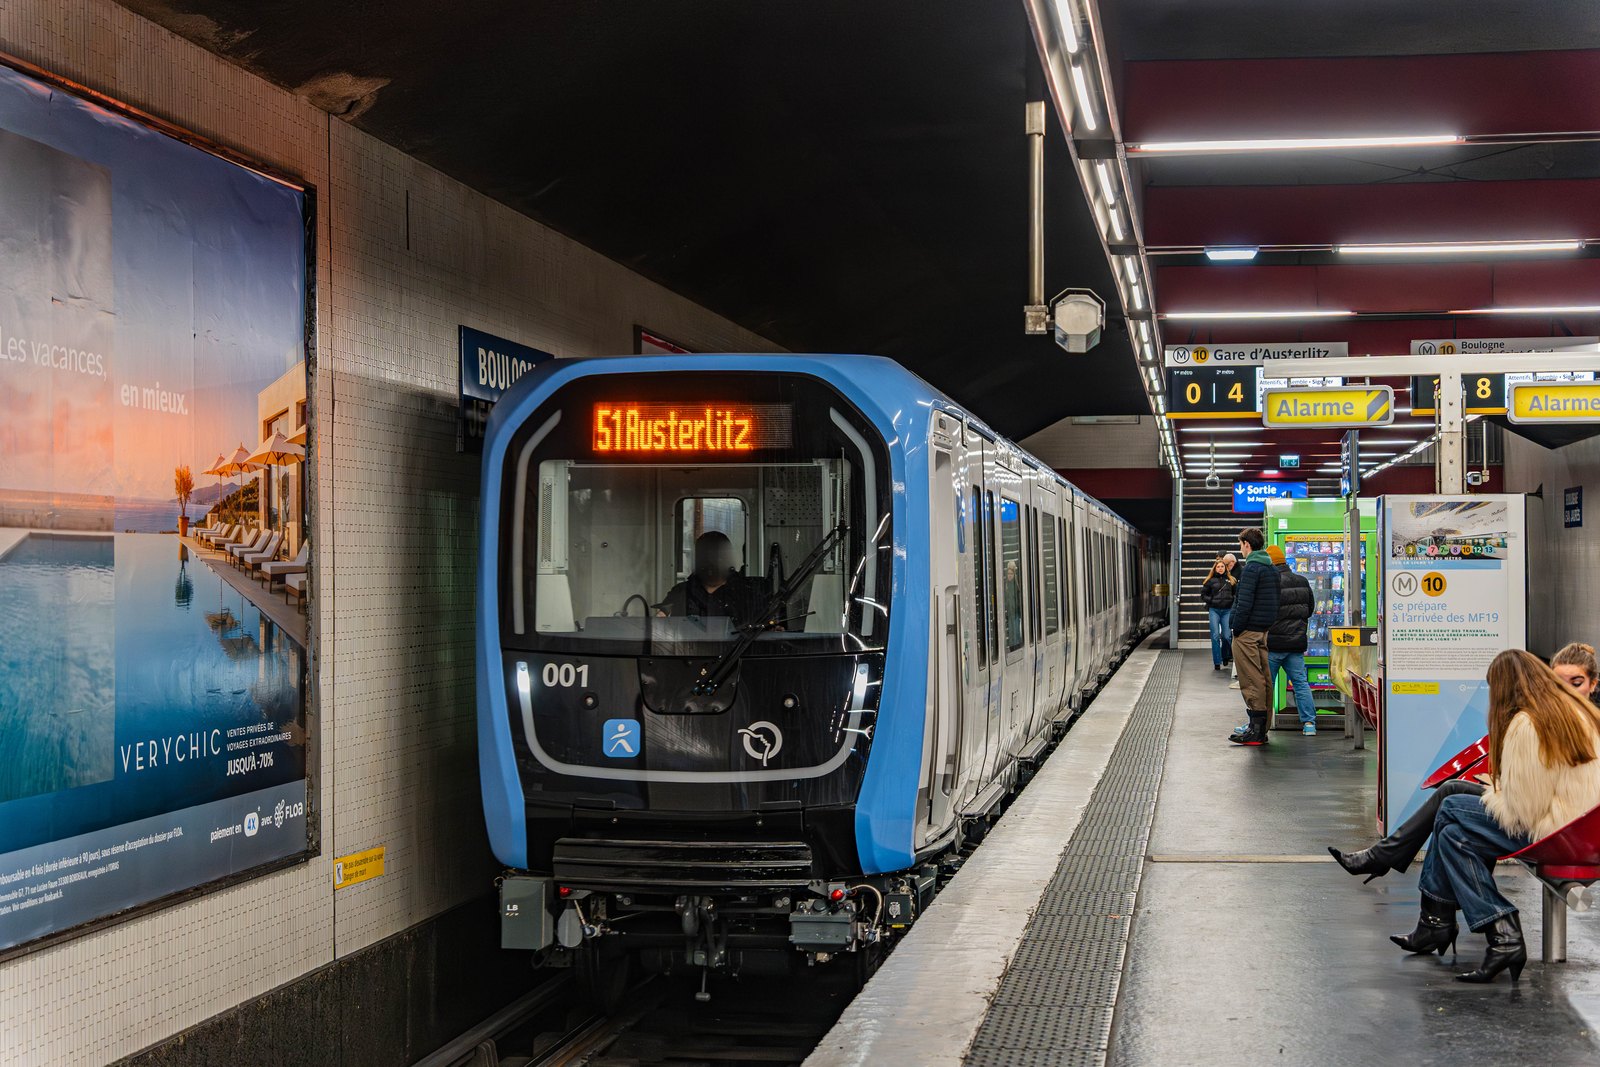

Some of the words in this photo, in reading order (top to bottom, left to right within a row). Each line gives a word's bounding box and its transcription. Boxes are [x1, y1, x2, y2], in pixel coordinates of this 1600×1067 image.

[1194, 350, 1206, 360] 10
[1214, 349, 1246, 360] Gare
[1250, 348, 1330, 360] d'Austerlitz
[1440, 346, 1454, 354] 10
[1462, 341, 1504, 350] Boulogne
[31, 341, 107, 382] vacances,
[478, 347, 536, 391] BOULO
[121, 382, 139, 407] en
[142, 381, 188, 415] mieux.
[1186, 382, 1201, 404] 0
[1228, 382, 1244, 403] 4
[1476, 378, 1492, 399] 8
[1276, 398, 1354, 418] Alarme
[1528, 394, 1600, 412] Alarme
[1247, 485, 1276, 494] Sortie
[1424, 578, 1442, 590] 10
[1408, 601, 1447, 613] prépare
[1392, 613, 1398, 622] à
[1402, 613, 1444, 622] l'arrivée
[1447, 613, 1464, 622] des
[1468, 613, 1499, 622] MF19
[542, 663, 589, 688] 001
[226, 726, 246, 738] VENTES
[246, 723, 267, 735] PRIVÉES
[267, 722, 274, 731] DE
[120, 728, 221, 773] VERYCHIC
[226, 739, 249, 751] VOYAGES
[250, 732, 292, 748] EXTRAORDINAIRES
[226, 752, 256, 776] JUSQU'À
[256, 752, 274, 770] -70%
[210, 824, 234, 844] paiement
[234, 824, 242, 834] en
[247, 818, 256, 830] 4X
[261, 816, 272, 826] avec
[25, 870, 31, 878] en
[82, 852, 88, 863] 90
